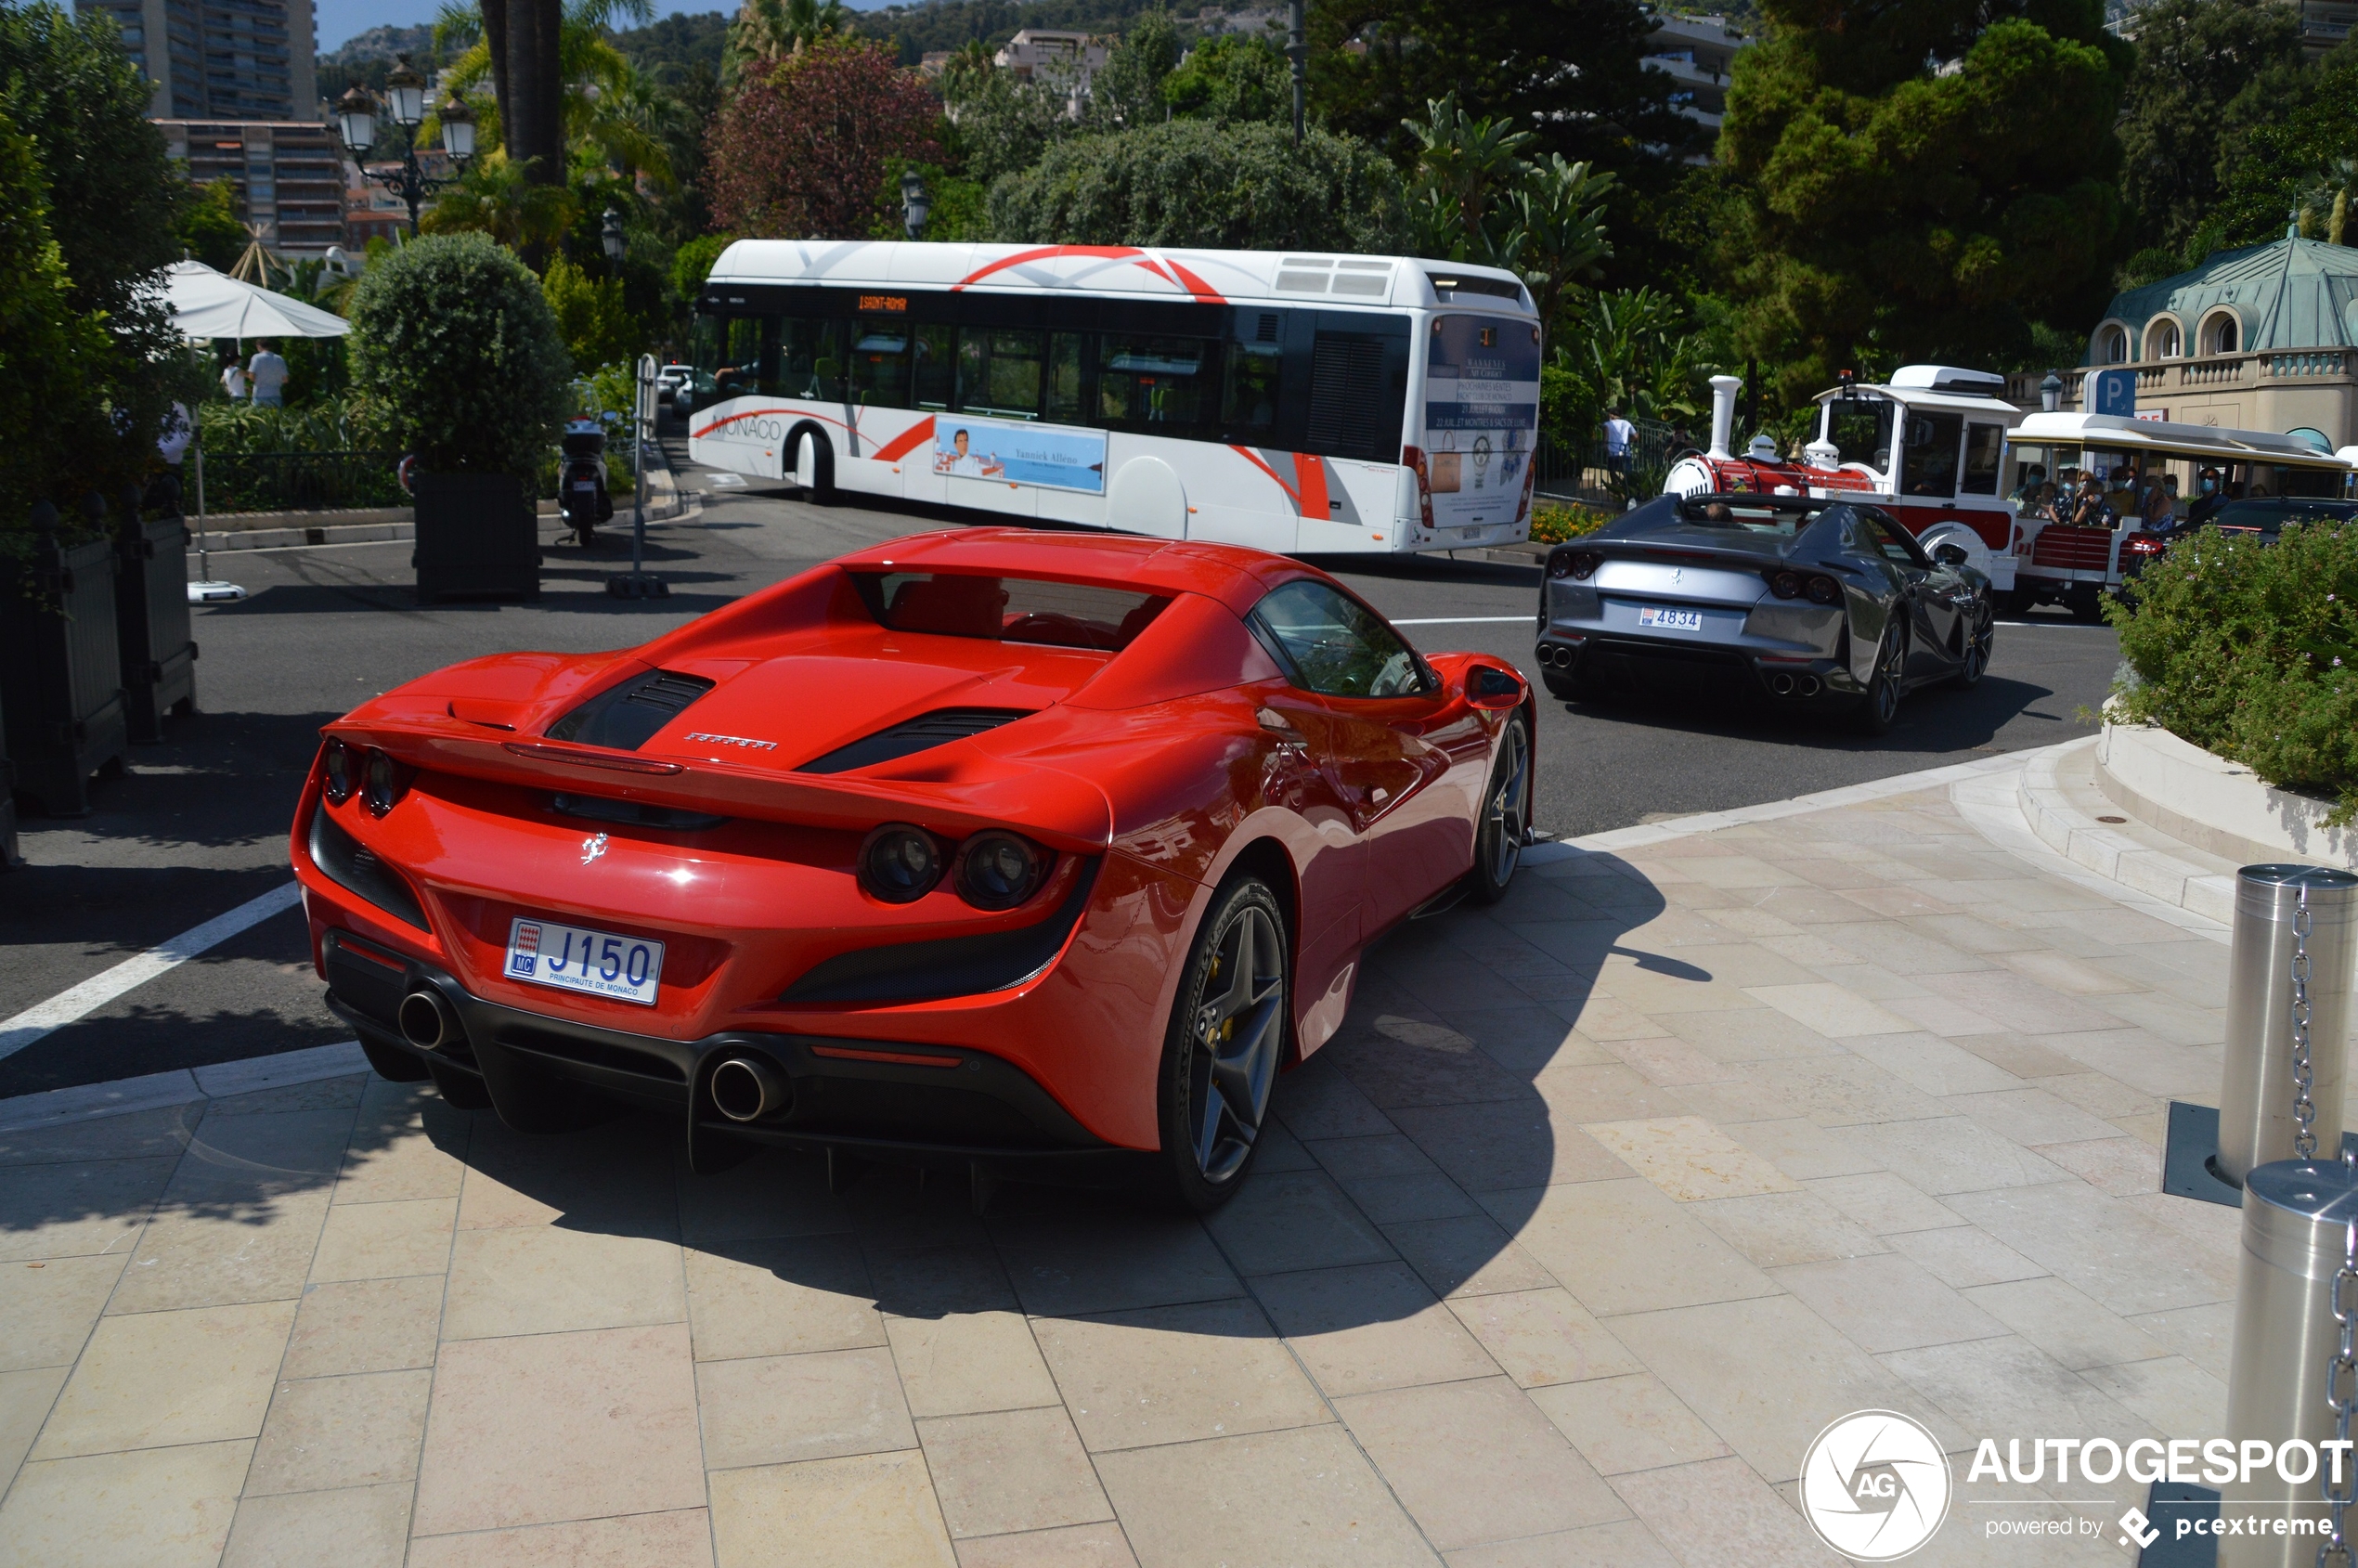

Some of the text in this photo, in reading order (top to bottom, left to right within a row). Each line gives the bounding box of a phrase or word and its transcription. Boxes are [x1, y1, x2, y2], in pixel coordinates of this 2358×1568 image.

[2106, 377, 2123, 408] P
[712, 414, 781, 440] MONACO
[1016, 448, 1048, 461] Yannick
[1657, 609, 1697, 627] 4834
[515, 957, 531, 971] MC
[548, 932, 650, 987] J150
[550, 973, 638, 996] PRINCIPAUTE DE MONACO
[1184, 969, 1204, 1054] MICHELIN
